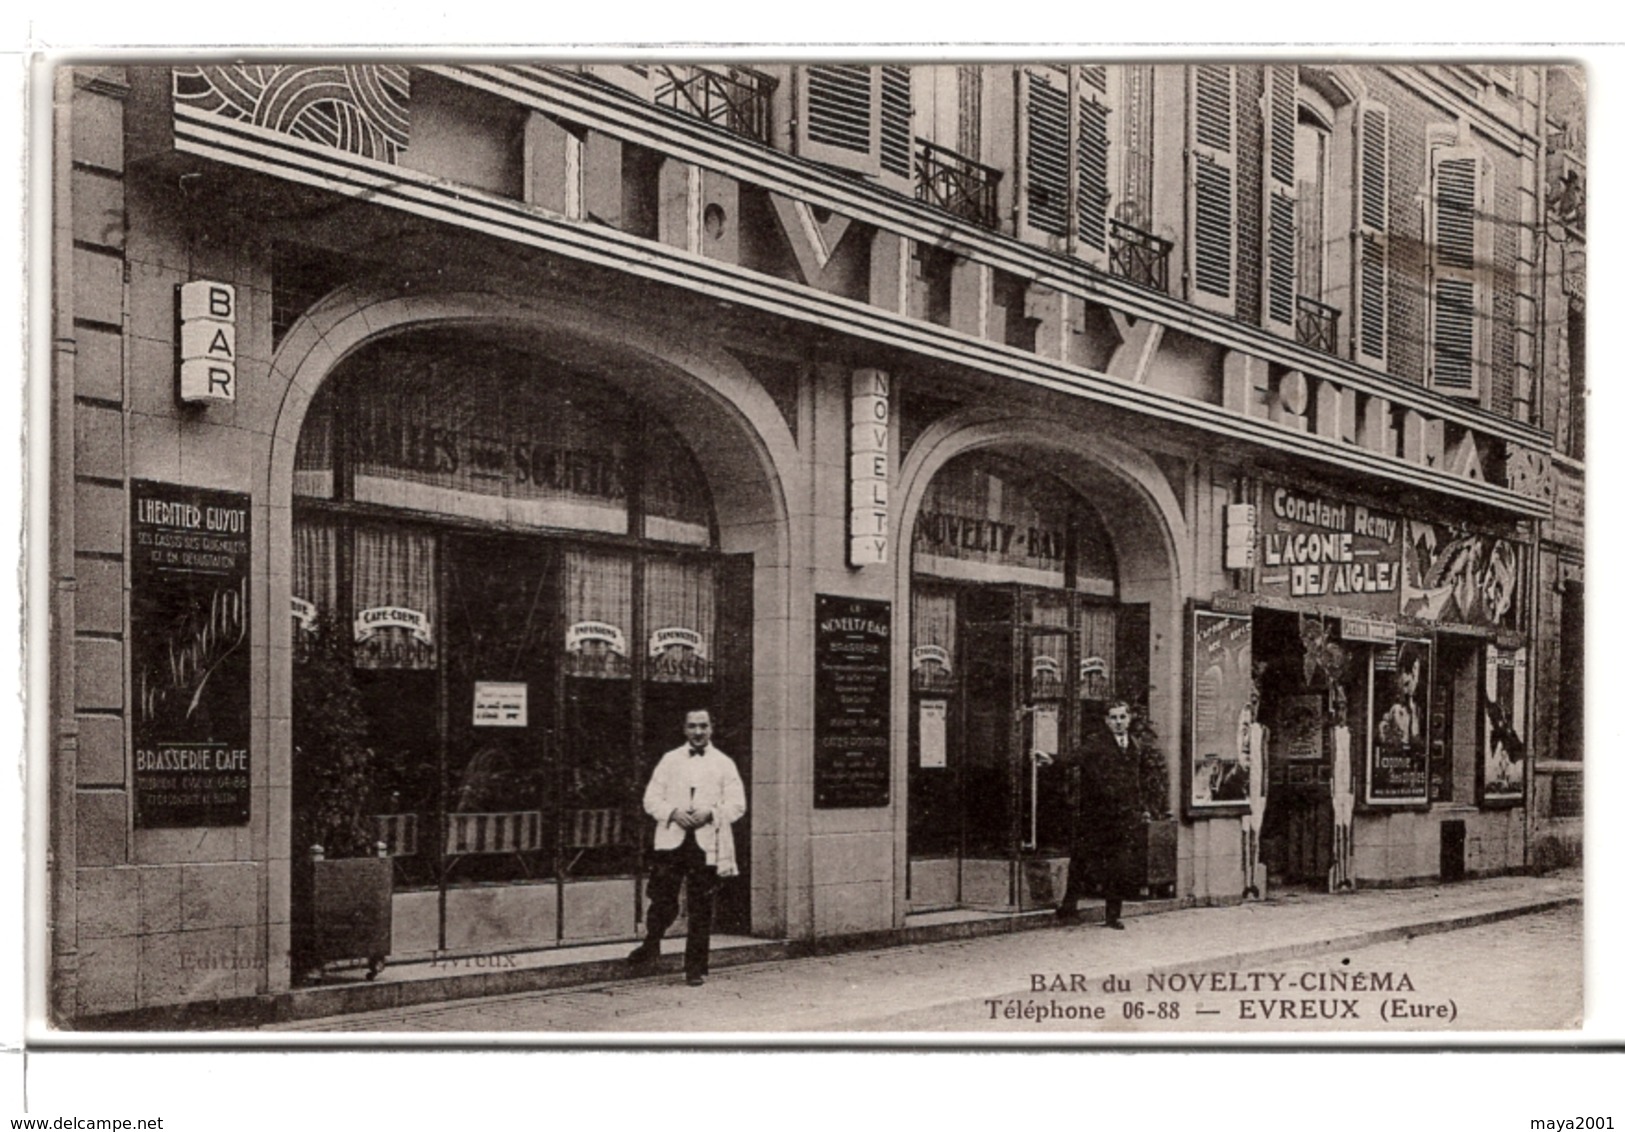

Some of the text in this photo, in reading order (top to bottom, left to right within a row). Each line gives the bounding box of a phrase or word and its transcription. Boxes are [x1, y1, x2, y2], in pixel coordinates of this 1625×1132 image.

[208, 286, 232, 396] BAR
[872, 373, 887, 560] NOVELTY
[206, 507, 246, 533] GUYOT
[1273, 488, 1346, 531] Constant
[1265, 533, 1353, 565] L'AGONIE
[1291, 562, 1399, 595] DES AIGLES
[137, 749, 247, 770] BRASSERIE CAFE
